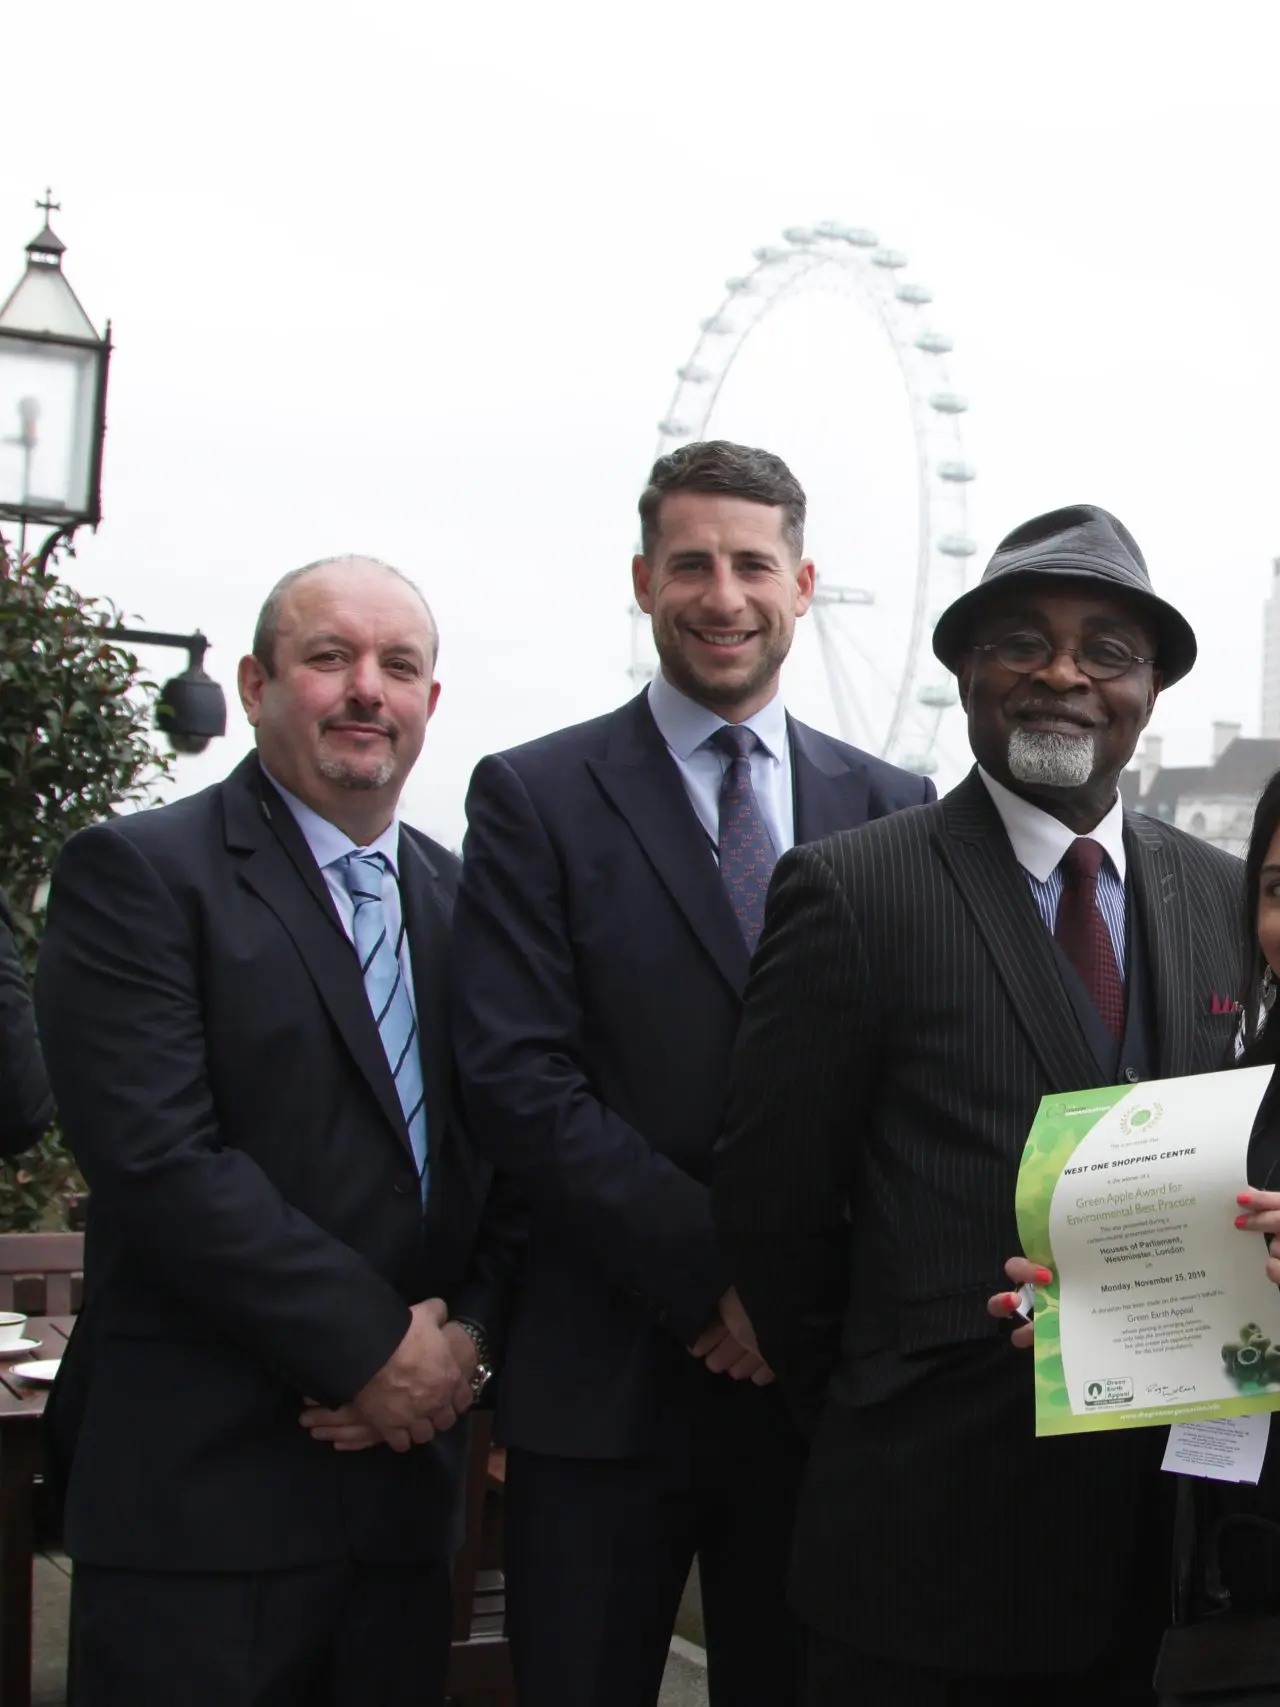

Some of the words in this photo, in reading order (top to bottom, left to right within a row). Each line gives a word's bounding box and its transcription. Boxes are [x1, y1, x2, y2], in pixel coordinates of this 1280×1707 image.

[1064, 1166, 1089, 1176] WEST
[1091, 1162, 1109, 1171] ONE
[1112, 1153, 1157, 1167] SHOPPING
[1160, 1147, 1197, 1160] CENTRE
[1076, 1196, 1105, 1209] Green
[1107, 1189, 1133, 1205] Apple
[1136, 1184, 1166, 1198] Award
[1169, 1181, 1183, 1192] for
[1067, 1204, 1133, 1226] Environmental
[1135, 1203, 1156, 1215] Best
[1158, 1196, 1196, 1210] Practice
[1100, 1246, 1129, 1256] Houses
[1130, 1241, 1139, 1250] of
[1140, 1236, 1183, 1249] Parliament,
[1104, 1251, 1154, 1264] Westminster,
[1155, 1246, 1185, 1257] London
[1101, 1281, 1133, 1293] Monday,
[1134, 1275, 1173, 1288] November
[1175, 1272, 1187, 1283] 25,
[1188, 1269, 1206, 1280] 2019
[1127, 1313, 1149, 1323] Green
[1151, 1309, 1170, 1319] Earth
[1170, 1306, 1194, 1320] Appeal
[1107, 1391, 1130, 1400] Appeal
